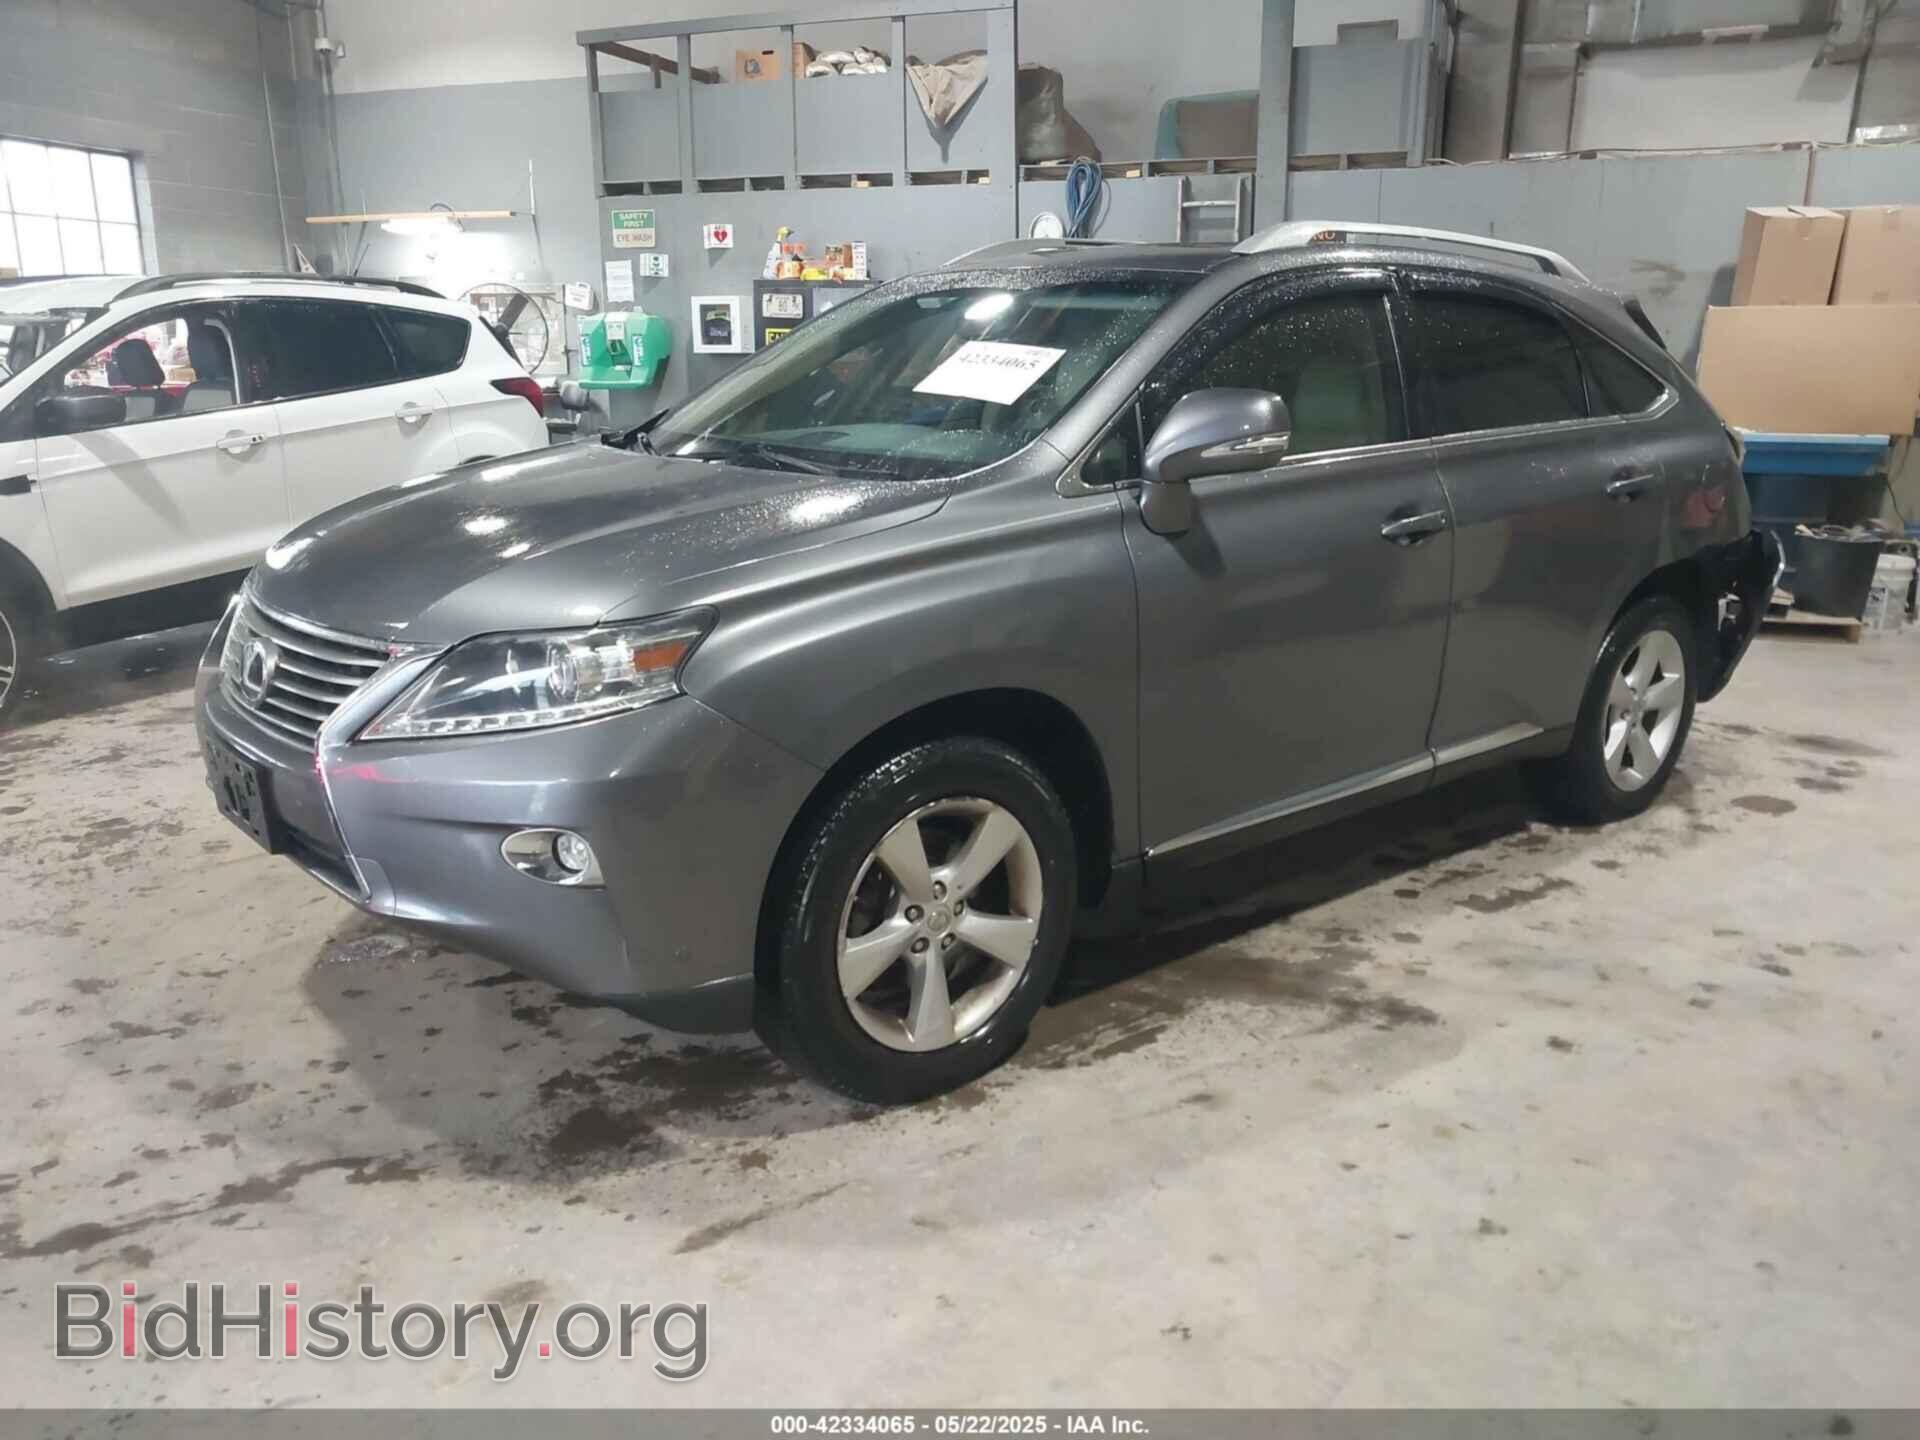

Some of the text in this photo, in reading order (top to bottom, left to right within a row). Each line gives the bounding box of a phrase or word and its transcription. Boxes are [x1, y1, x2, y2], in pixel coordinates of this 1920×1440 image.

[619, 212, 648, 220] SAFETY
[623, 220, 645, 228] FIRST
[616, 233, 652, 242] EYE WASH
[959, 353, 1041, 370] 42334065
